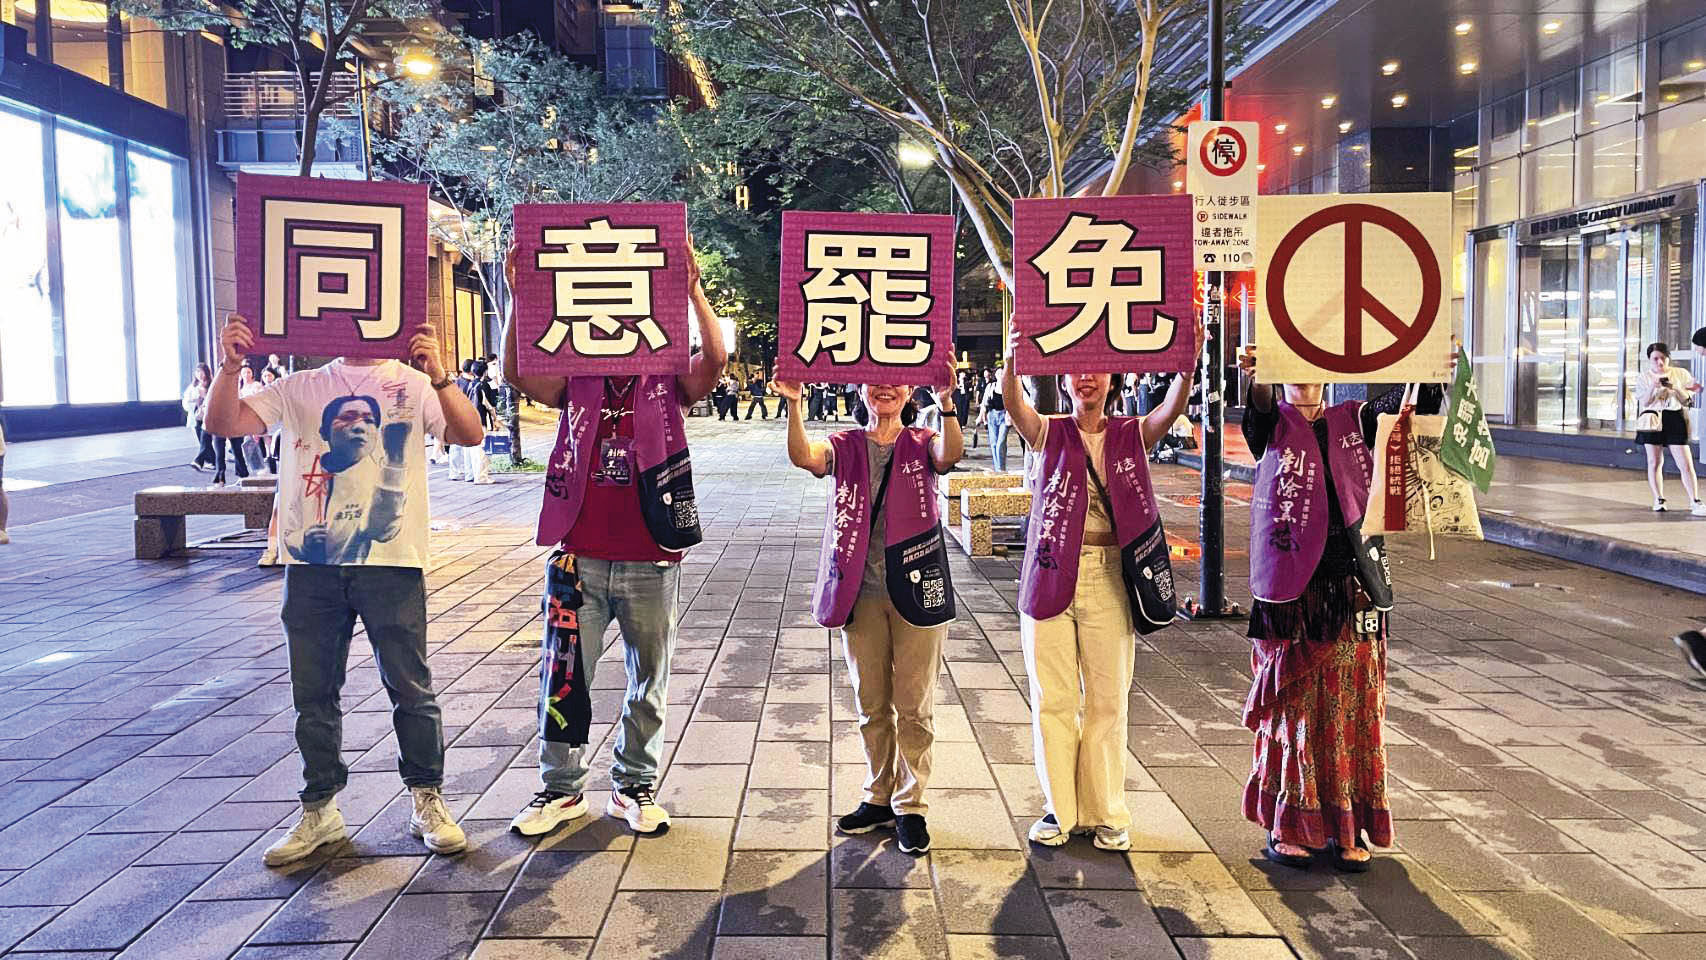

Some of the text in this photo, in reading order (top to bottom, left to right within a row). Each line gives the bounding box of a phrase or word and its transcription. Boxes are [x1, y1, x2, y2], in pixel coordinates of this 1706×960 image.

[1212, 138, 1236, 164] 停
[1194, 195, 1250, 207] 行人徒步區
[1624, 195, 1676, 214] LANDMARK
[1201, 227, 1243, 238] 違者拖吊
[259, 196, 404, 342] 同
[1223, 253, 1240, 263] 110
[537, 219, 668, 358] 意
[796, 228, 934, 365] 罷
[1026, 211, 1179, 357] 免
